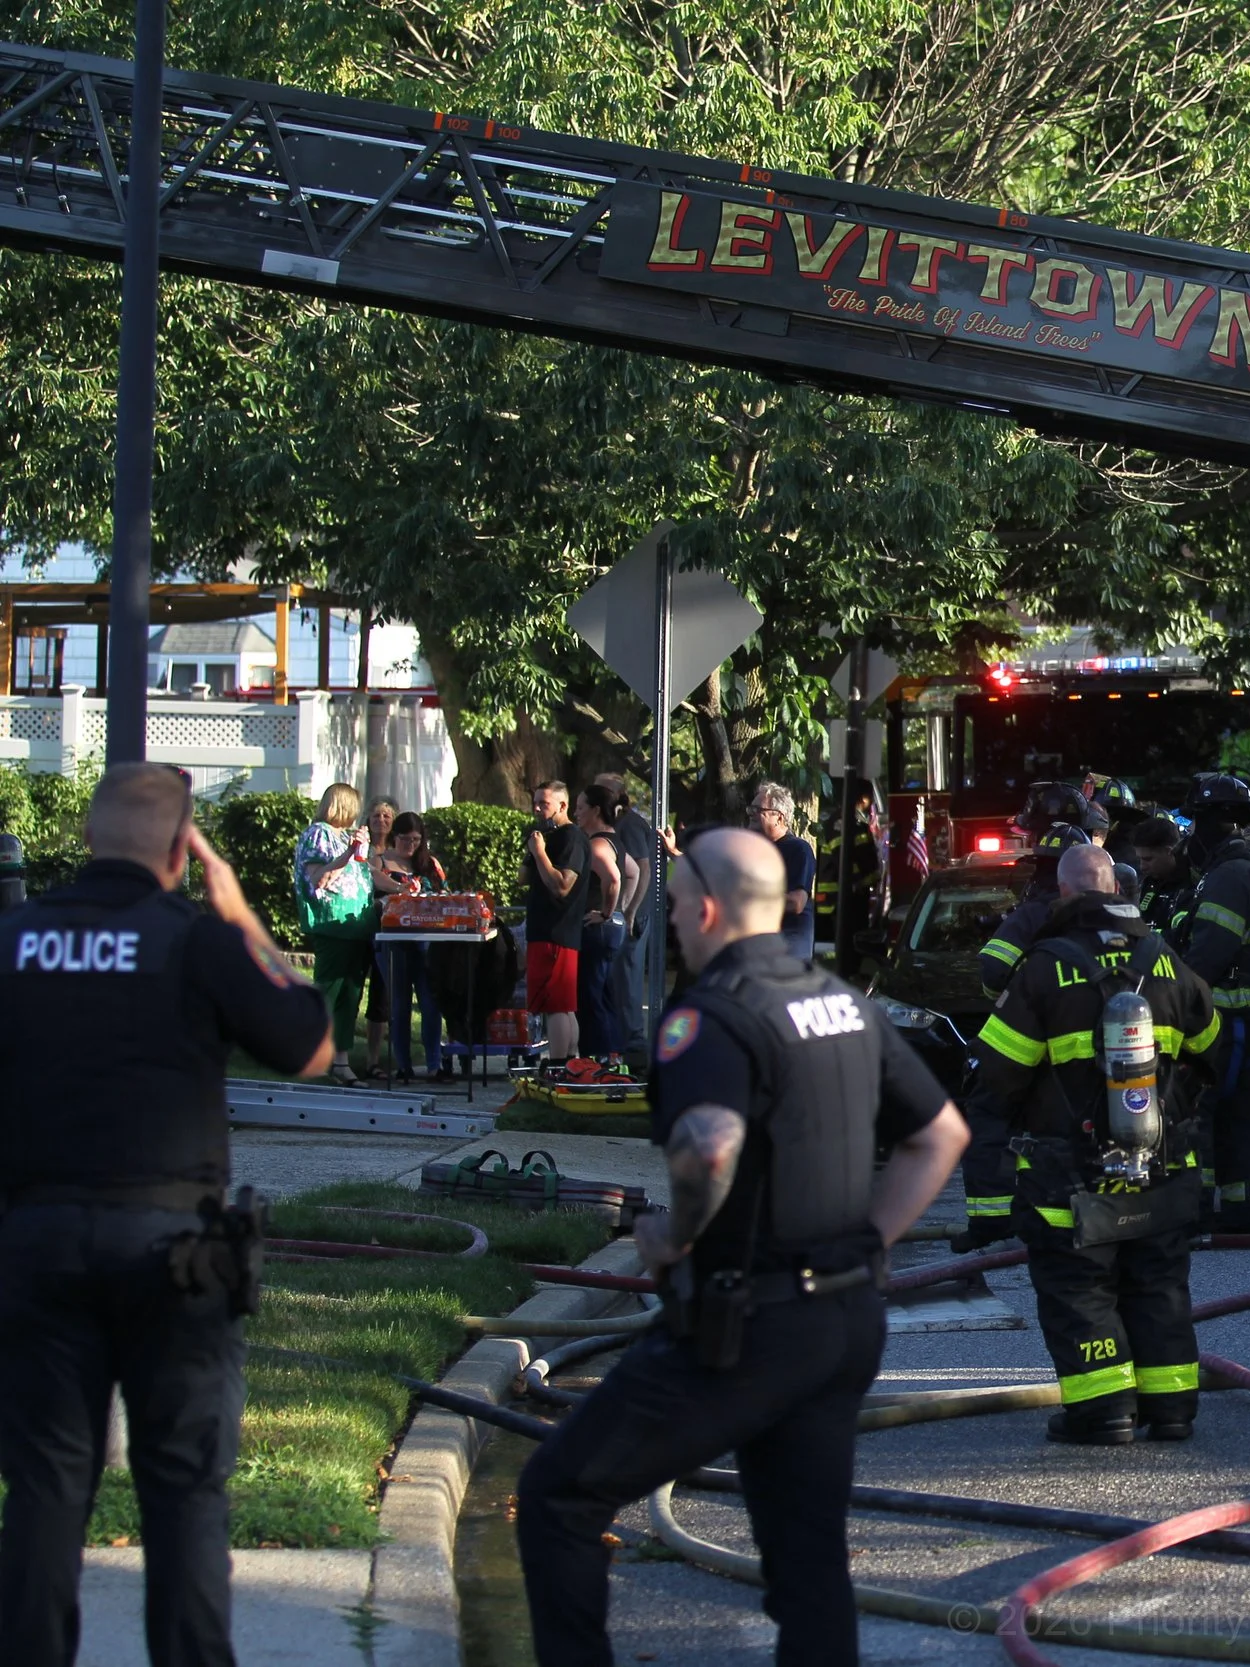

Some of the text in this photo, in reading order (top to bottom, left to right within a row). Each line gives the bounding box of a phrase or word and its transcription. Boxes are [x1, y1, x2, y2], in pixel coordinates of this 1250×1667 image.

[447, 118, 470, 131] 102
[499, 127, 521, 140] 100
[753, 170, 772, 183] 90
[1010, 215, 1028, 227] 80
[873, 295, 926, 323] Pride
[933, 306, 961, 335] Of
[963, 311, 1034, 342] Island
[16, 930, 140, 972] POLICE
[786, 993, 866, 1040] POLICE
[1122, 1027, 1139, 1036] 3M
[1080, 1338, 1117, 1362] 728
